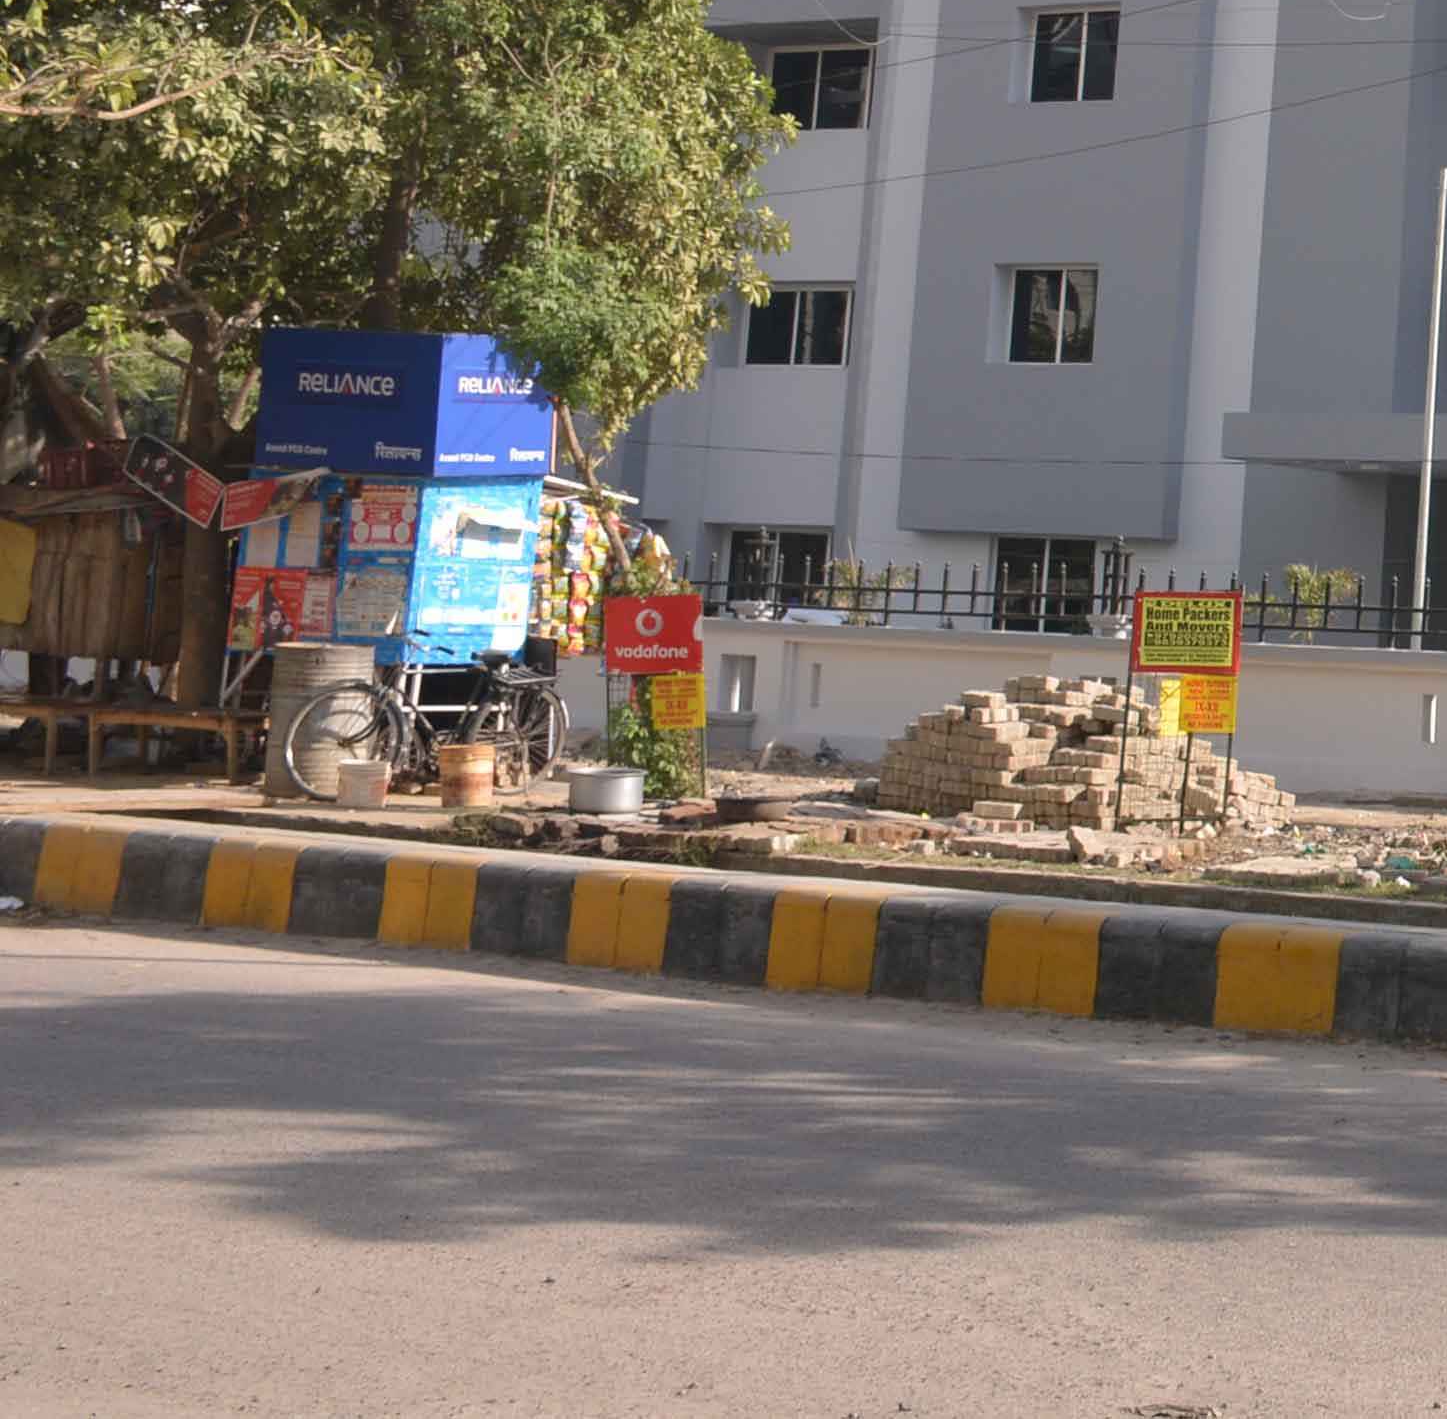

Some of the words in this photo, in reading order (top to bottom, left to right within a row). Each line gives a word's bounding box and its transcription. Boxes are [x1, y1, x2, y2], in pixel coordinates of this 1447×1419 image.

[298, 372, 395, 396] RELIANCE
[1146, 607, 1180, 620] Home
[1183, 608, 1230, 622] Packers
[1146, 622, 1172, 631] And
[1177, 622, 1229, 631] Movers
[614, 644, 688, 659] vodafone
